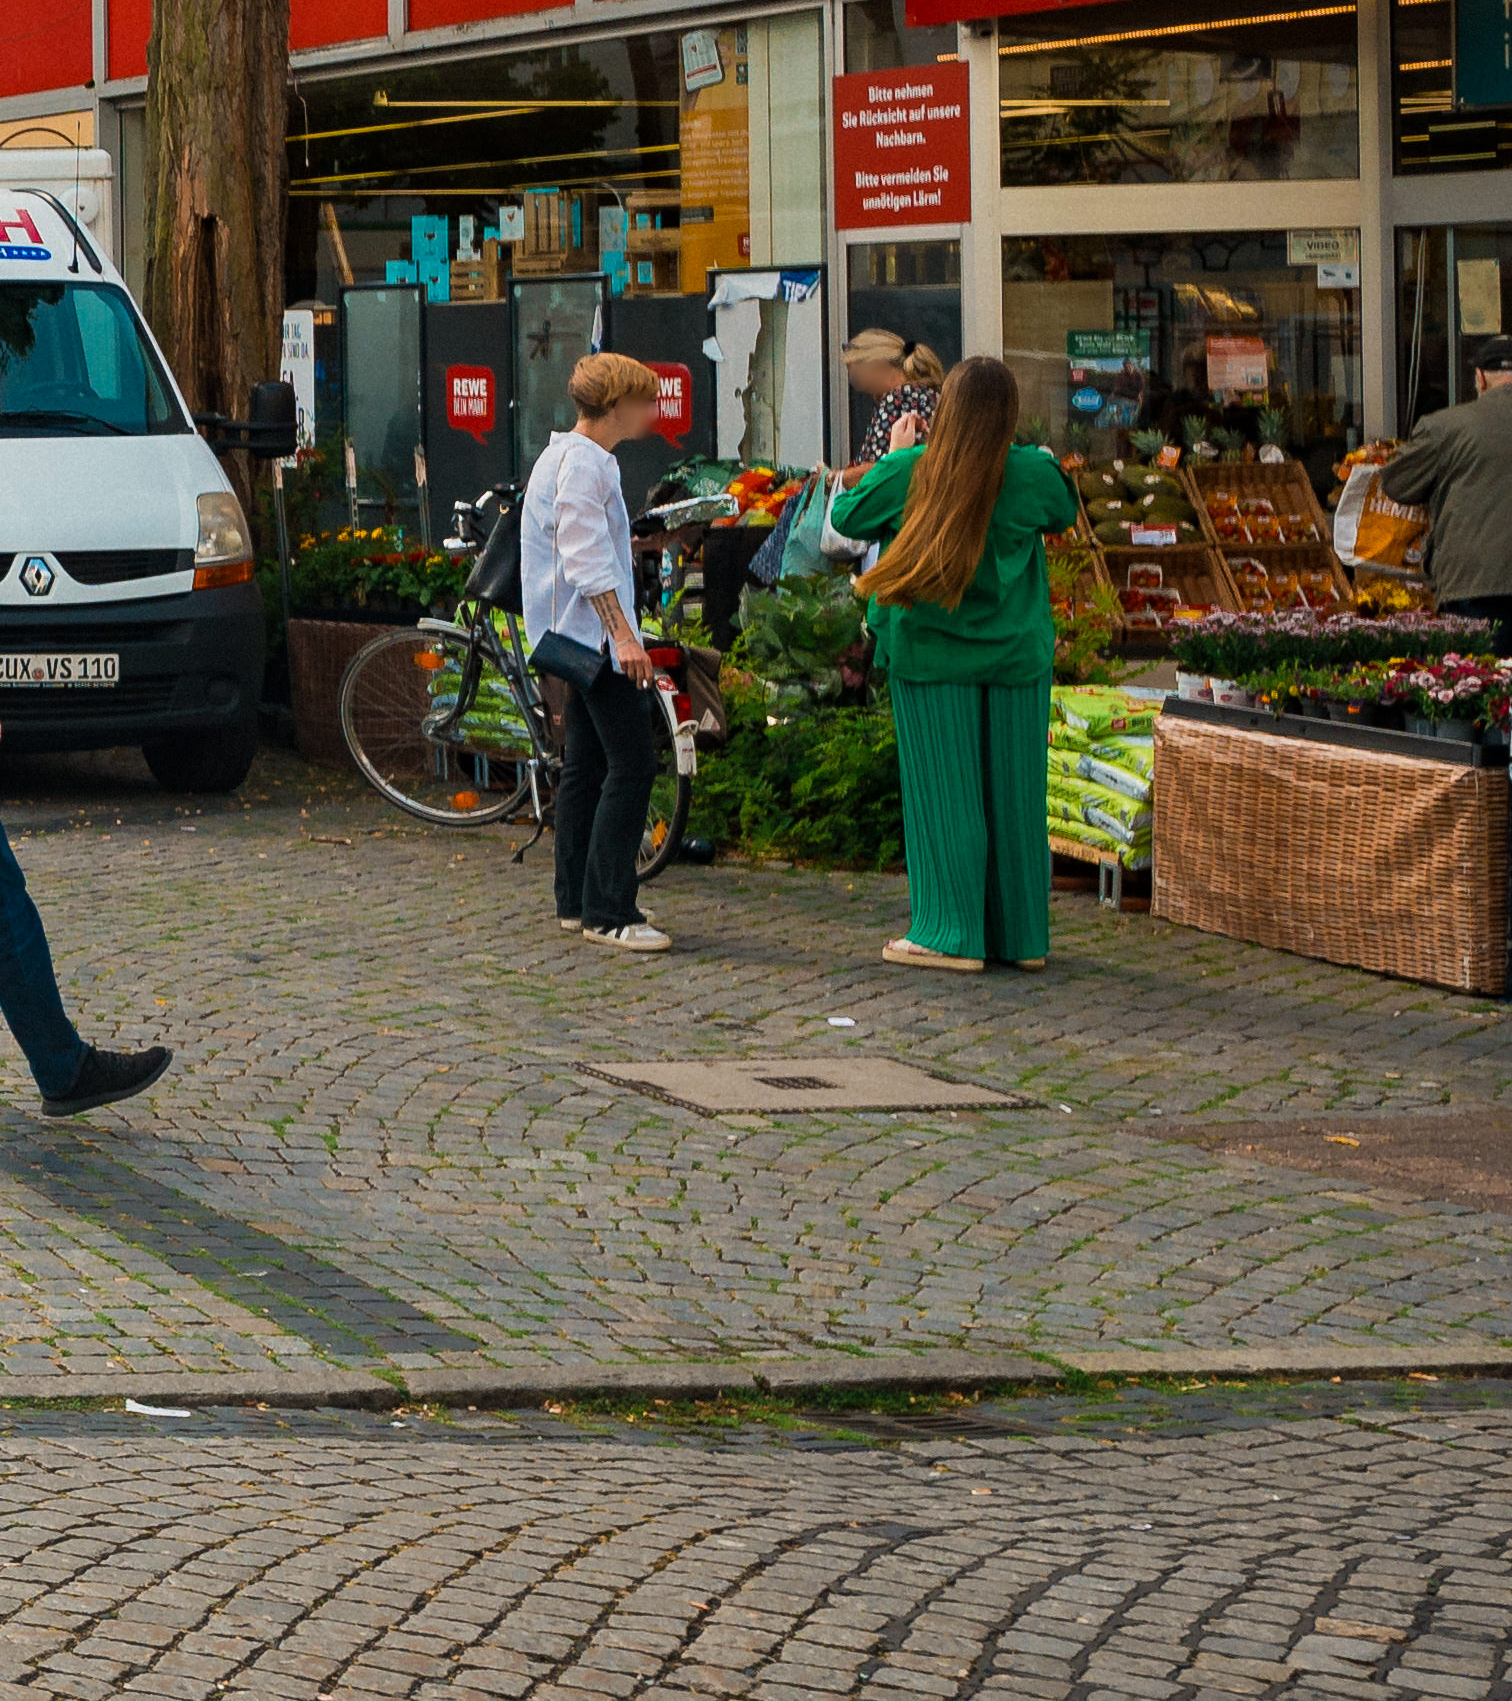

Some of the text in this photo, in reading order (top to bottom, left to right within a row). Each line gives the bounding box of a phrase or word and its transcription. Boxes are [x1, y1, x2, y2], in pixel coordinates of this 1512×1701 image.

[868, 82, 934, 103] Bitte nehmen
[842, 103, 961, 129] Sie Rücksicht auf unsere
[875, 129, 927, 148] Nachbarn.
[855, 164, 949, 189] Bitte vermeiden Sie
[862, 188, 942, 212] unnötigen Lärm!
[453, 377, 488, 397] REWE
[657, 377, 683, 398] WE
[46, 657, 72, 680] VS
[77, 657, 116, 680] 110
